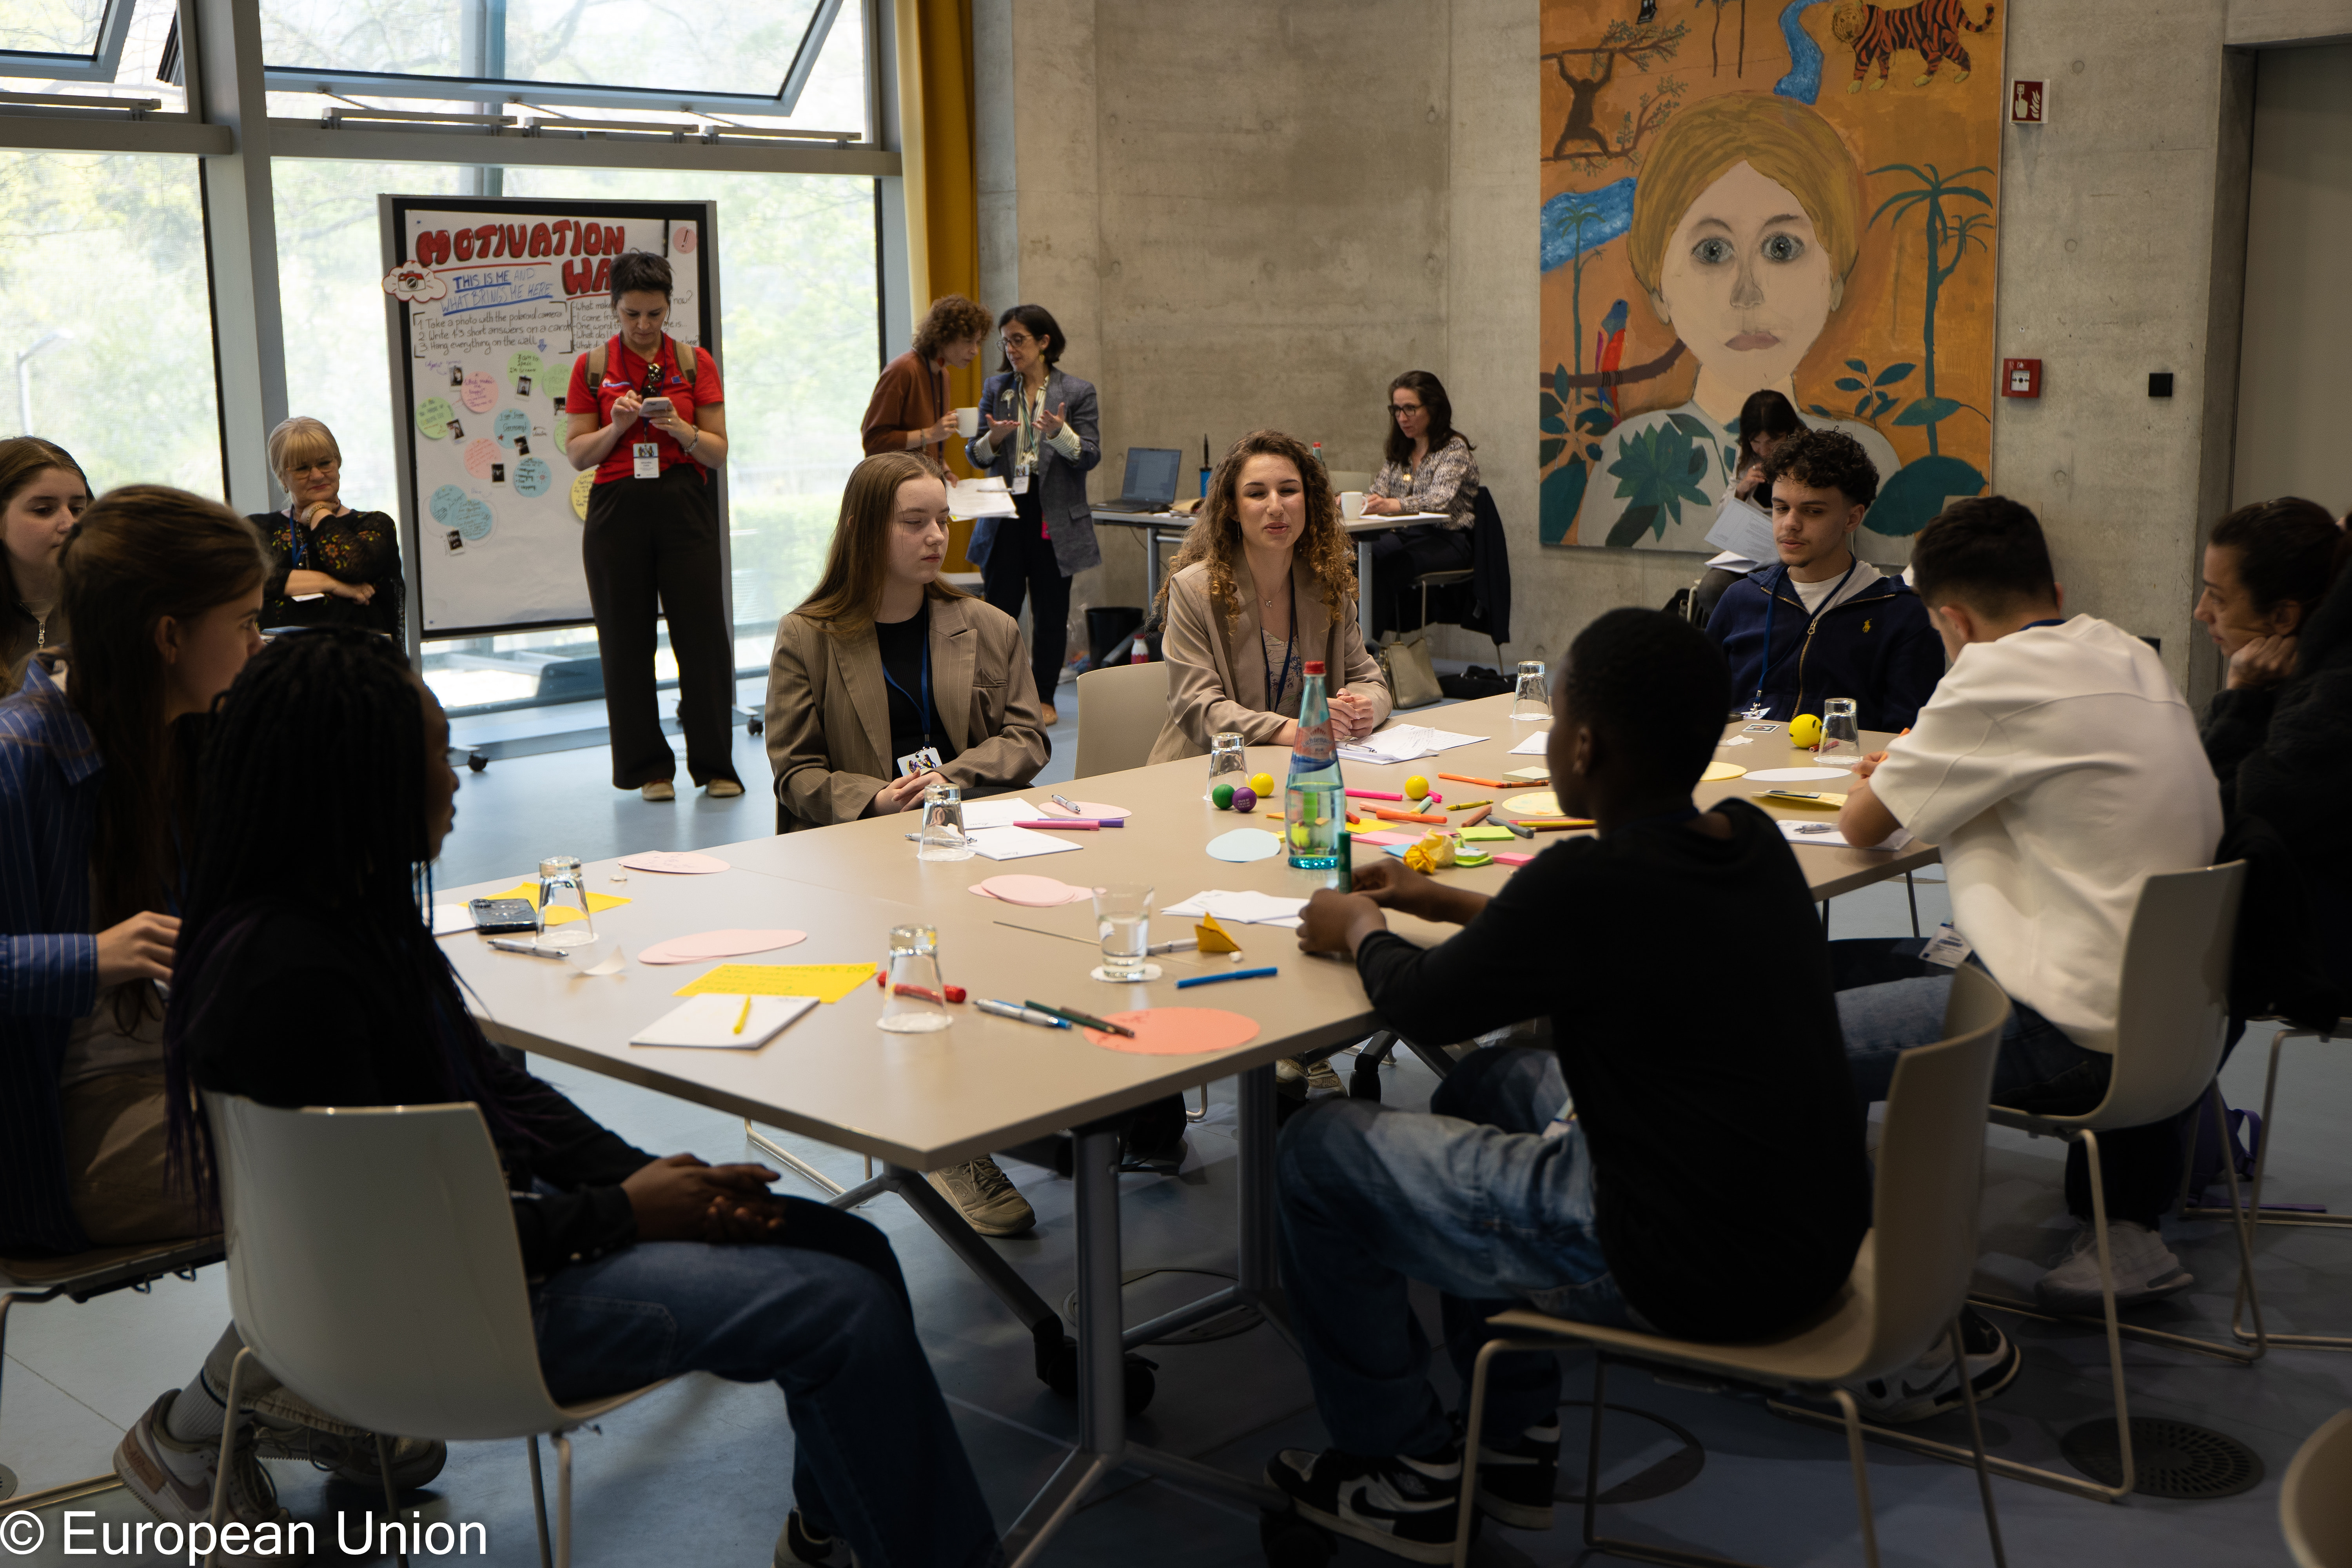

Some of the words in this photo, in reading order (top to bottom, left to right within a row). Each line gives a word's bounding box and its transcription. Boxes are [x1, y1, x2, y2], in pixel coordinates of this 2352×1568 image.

[416, 220, 624, 267] MOTIVATION
[453, 274, 479, 289] THIS
[484, 273, 492, 285] IS
[496, 270, 510, 282] ME
[514, 267, 535, 280] AND
[562, 257, 611, 295] WA
[440, 293, 470, 312] WHAT
[471, 286, 508, 306] BRINGS
[510, 284, 524, 300] ME
[527, 281, 553, 296] HERE
[673, 290, 693, 305] now?
[425, 317, 445, 328] Take
[455, 313, 477, 330] photo
[479, 310, 494, 324] with
[495, 310, 506, 323] the
[593, 321, 612, 330] word
[428, 328, 449, 341] Write
[466, 323, 487, 337] short
[488, 325, 524, 334] answers
[526, 325, 538, 334] on
[539, 325, 546, 333] a
[595, 329, 606, 339] do
[430, 341, 449, 356] Hang
[450, 338, 491, 355] everything
[504, 335, 515, 347] the
[518, 334, 538, 345] wall
